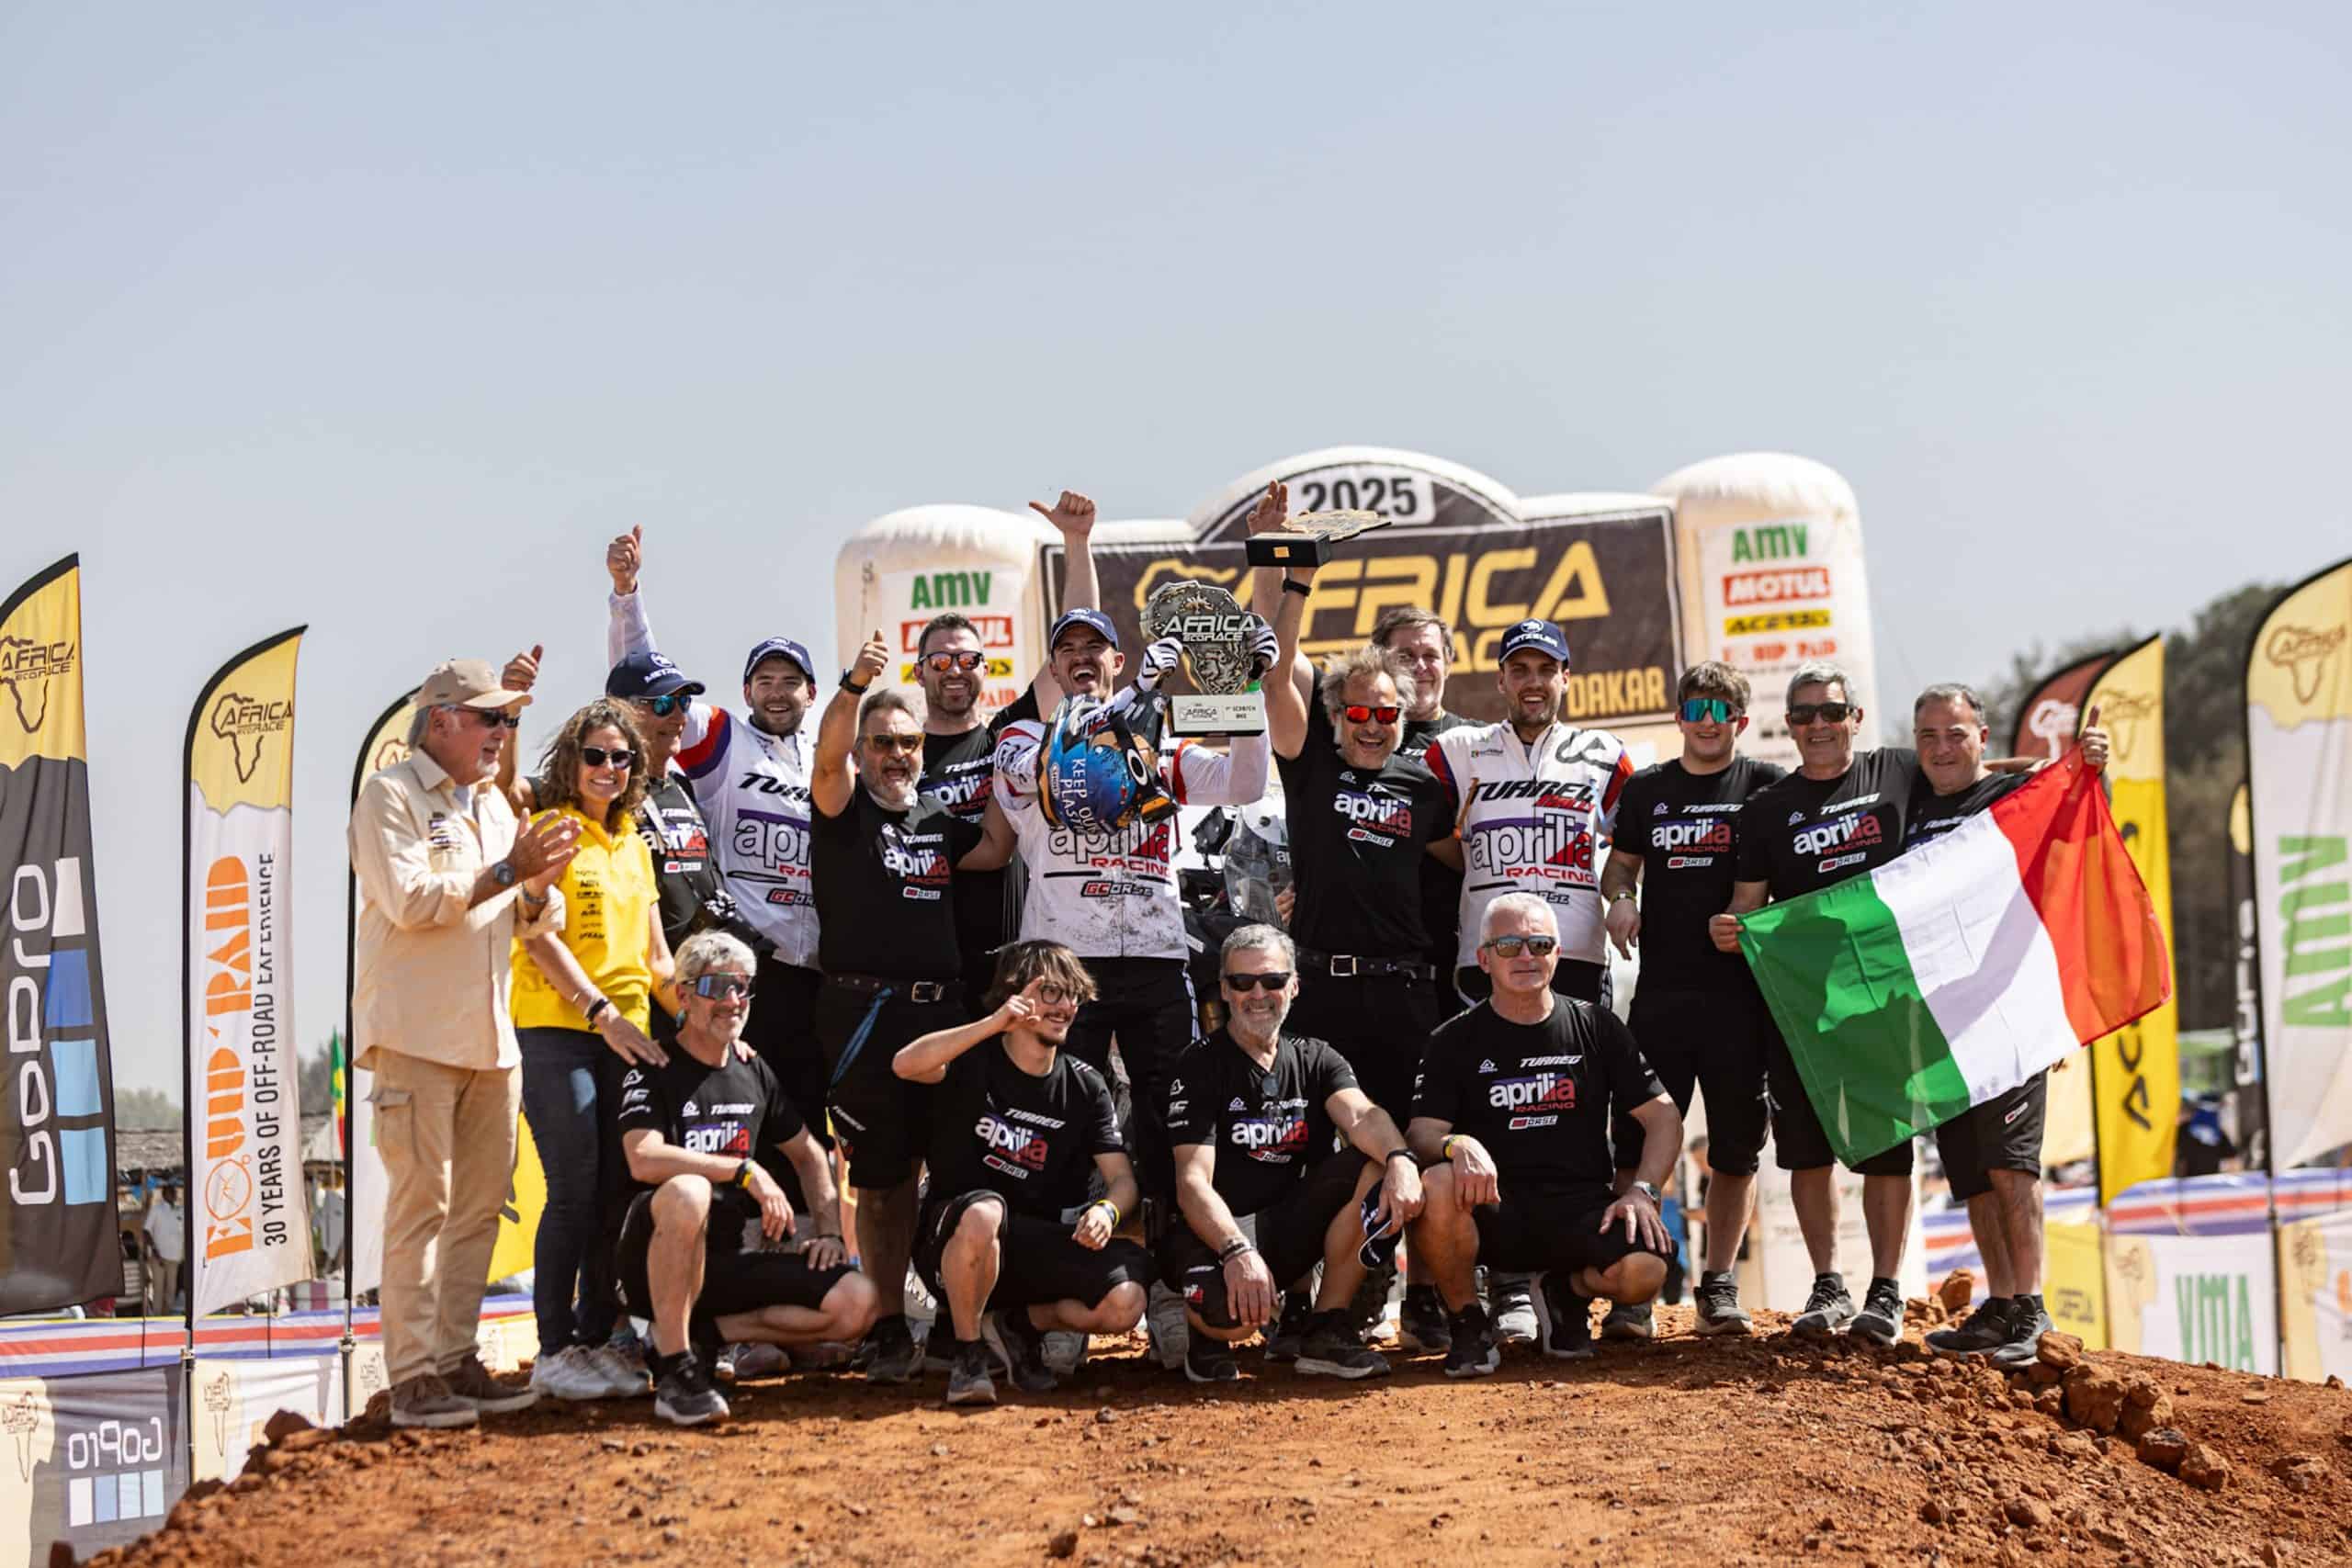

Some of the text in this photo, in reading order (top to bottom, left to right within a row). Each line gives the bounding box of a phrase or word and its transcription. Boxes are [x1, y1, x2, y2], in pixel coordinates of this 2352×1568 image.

[1301, 478, 1418, 517] 2025
[1233, 540, 1611, 638] FRICA
[1728, 571, 1826, 603] MOTUL
[903, 619, 1010, 651] MUL
[1161, 615, 1257, 637] AFRICA
[1566, 666, 1668, 719] DAKAR
[220, 700, 293, 731] AFRICA
[1071, 758, 1088, 801] KEEP
[1334, 793, 1412, 831] aprilia
[1048, 820, 1170, 864] aprilia
[1471, 813, 1592, 876] aprilia
[1651, 818, 1732, 852] aprilia
[1792, 812, 1882, 856] aprilia
[884, 846, 950, 878] aprilia
[1505, 866, 1595, 884] RACING
[252, 992, 279, 1104] OFF-ROAD
[1489, 1073, 1576, 1111] aprilia
[1515, 1102, 1576, 1112] RACING
[256, 1111, 280, 1139] OF
[684, 1121, 750, 1152] aprilia
[975, 1116, 1048, 1165] aprilia
[258, 1145, 284, 1217] YEARS
[264, 1221, 288, 1247] 30
